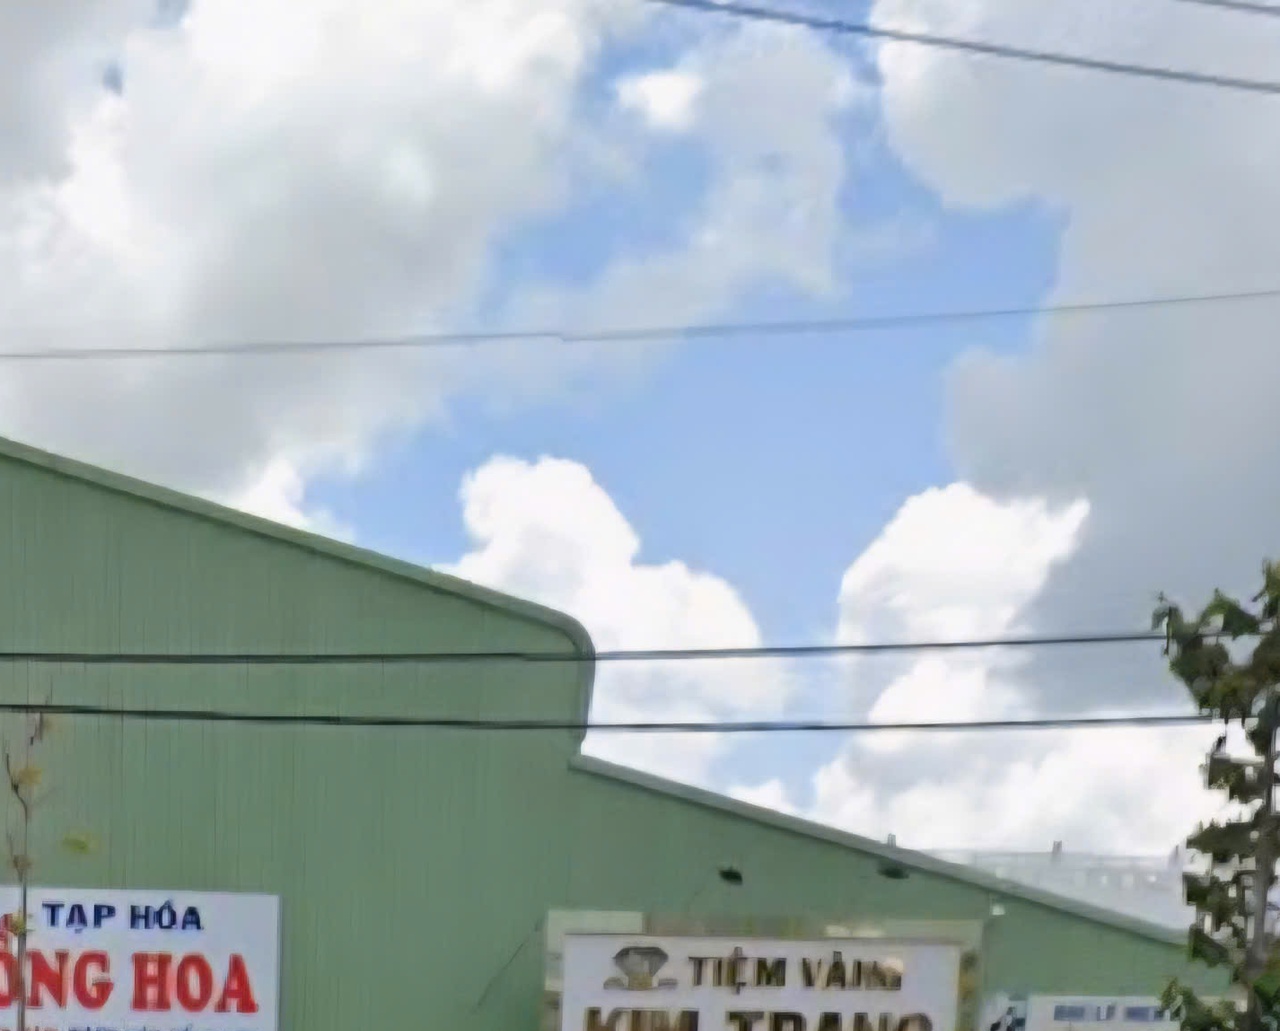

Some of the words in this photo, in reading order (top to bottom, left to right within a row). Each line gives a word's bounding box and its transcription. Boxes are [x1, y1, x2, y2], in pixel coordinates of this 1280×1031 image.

[42, 901, 116, 934] TẠP
[131, 951, 260, 1014] HOA
[687, 946, 787, 994] TIỆM
